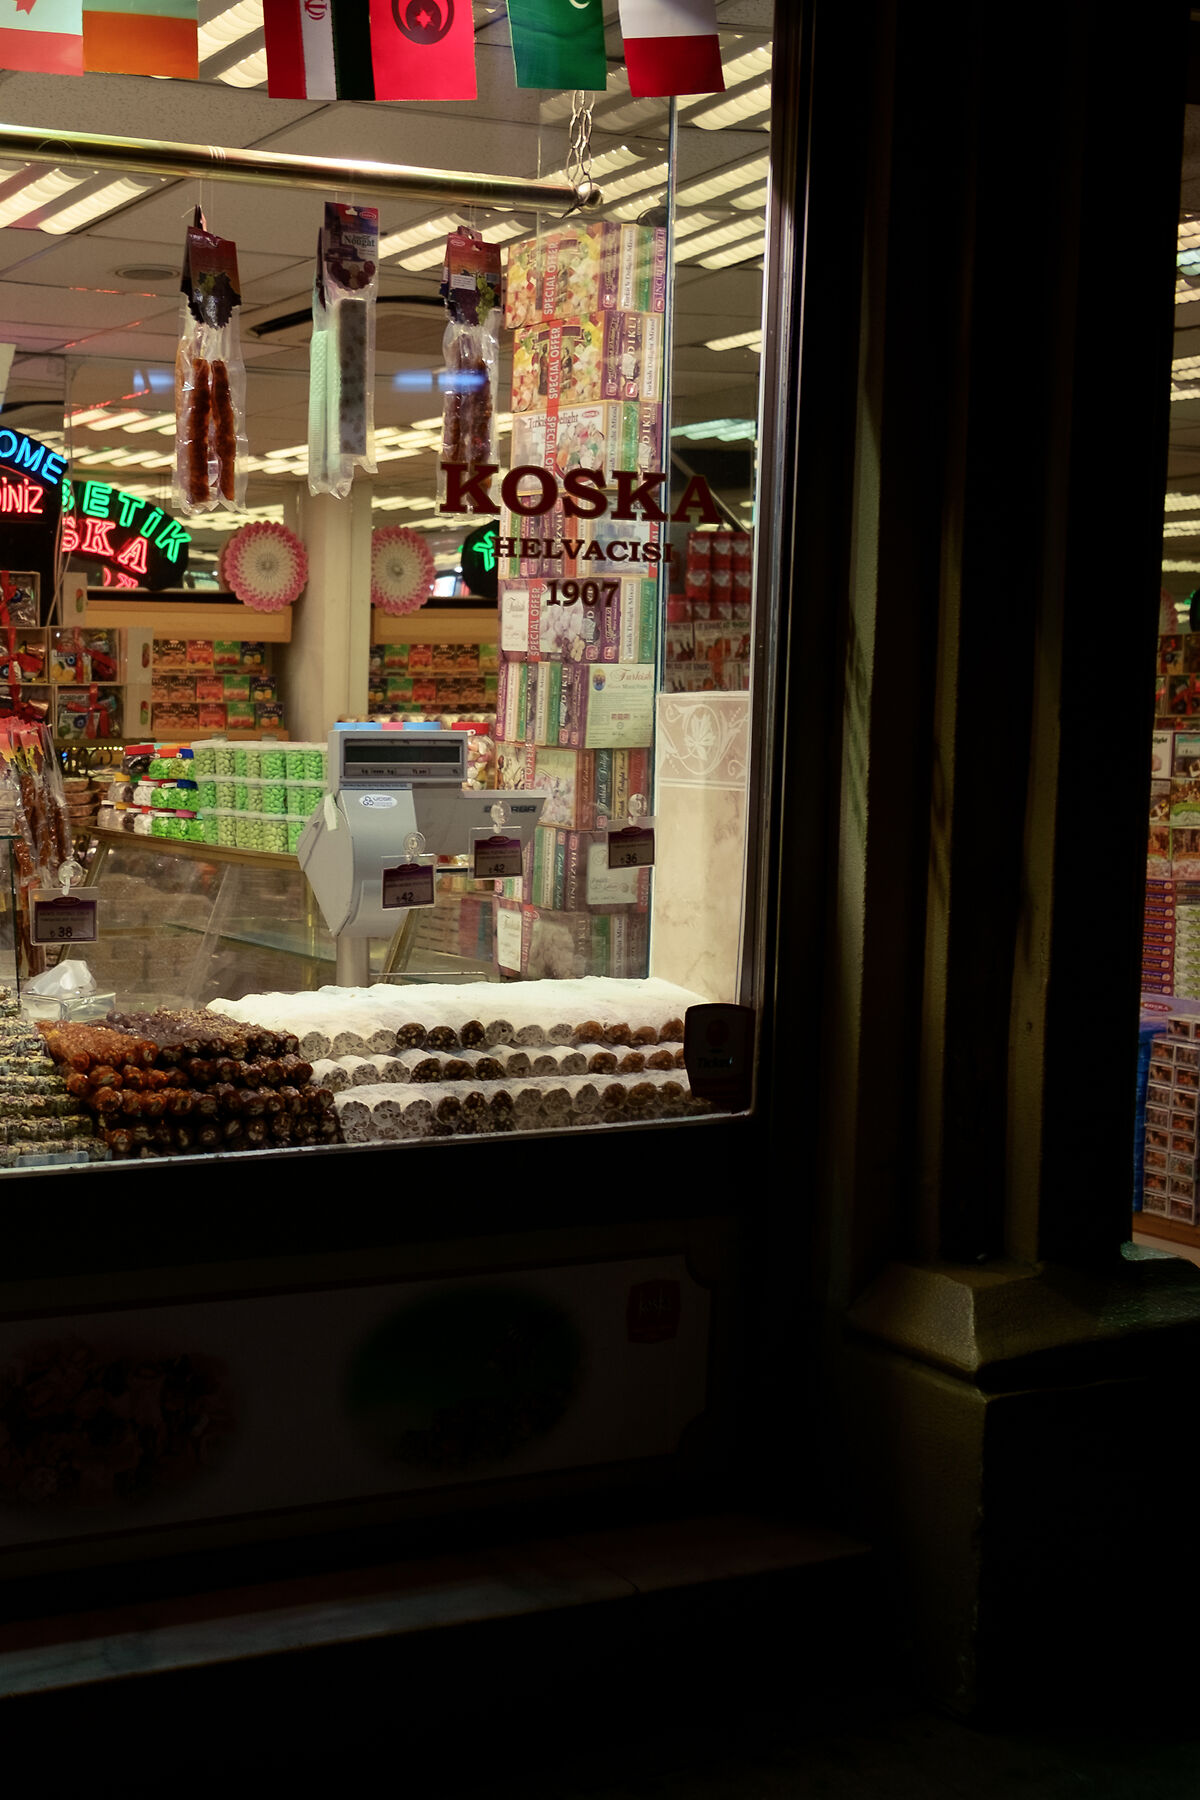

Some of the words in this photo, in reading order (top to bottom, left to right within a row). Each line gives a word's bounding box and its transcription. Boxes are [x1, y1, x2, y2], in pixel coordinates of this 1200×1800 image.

[344, 235, 375, 248] Nougat
[547, 242, 559, 273] OFFER
[543, 275, 556, 315] SPECIAL
[550, 327, 561, 358] OFFER
[548, 360, 560, 399] SPECIAL
[559, 411, 579, 427] elight
[545, 416, 556, 455] SPECIAL
[440, 462, 722, 524] KOSKA
[493, 536, 675, 564] HELVACISI
[530, 587, 540, 617] OFFER
[546, 581, 619, 607] 1907
[530, 617, 540, 657] SPECIAL
[493, 863, 505, 873] 42
[625, 853, 637, 864] 36
[401, 891, 414, 903] 42
[58, 926, 73, 938] 38
